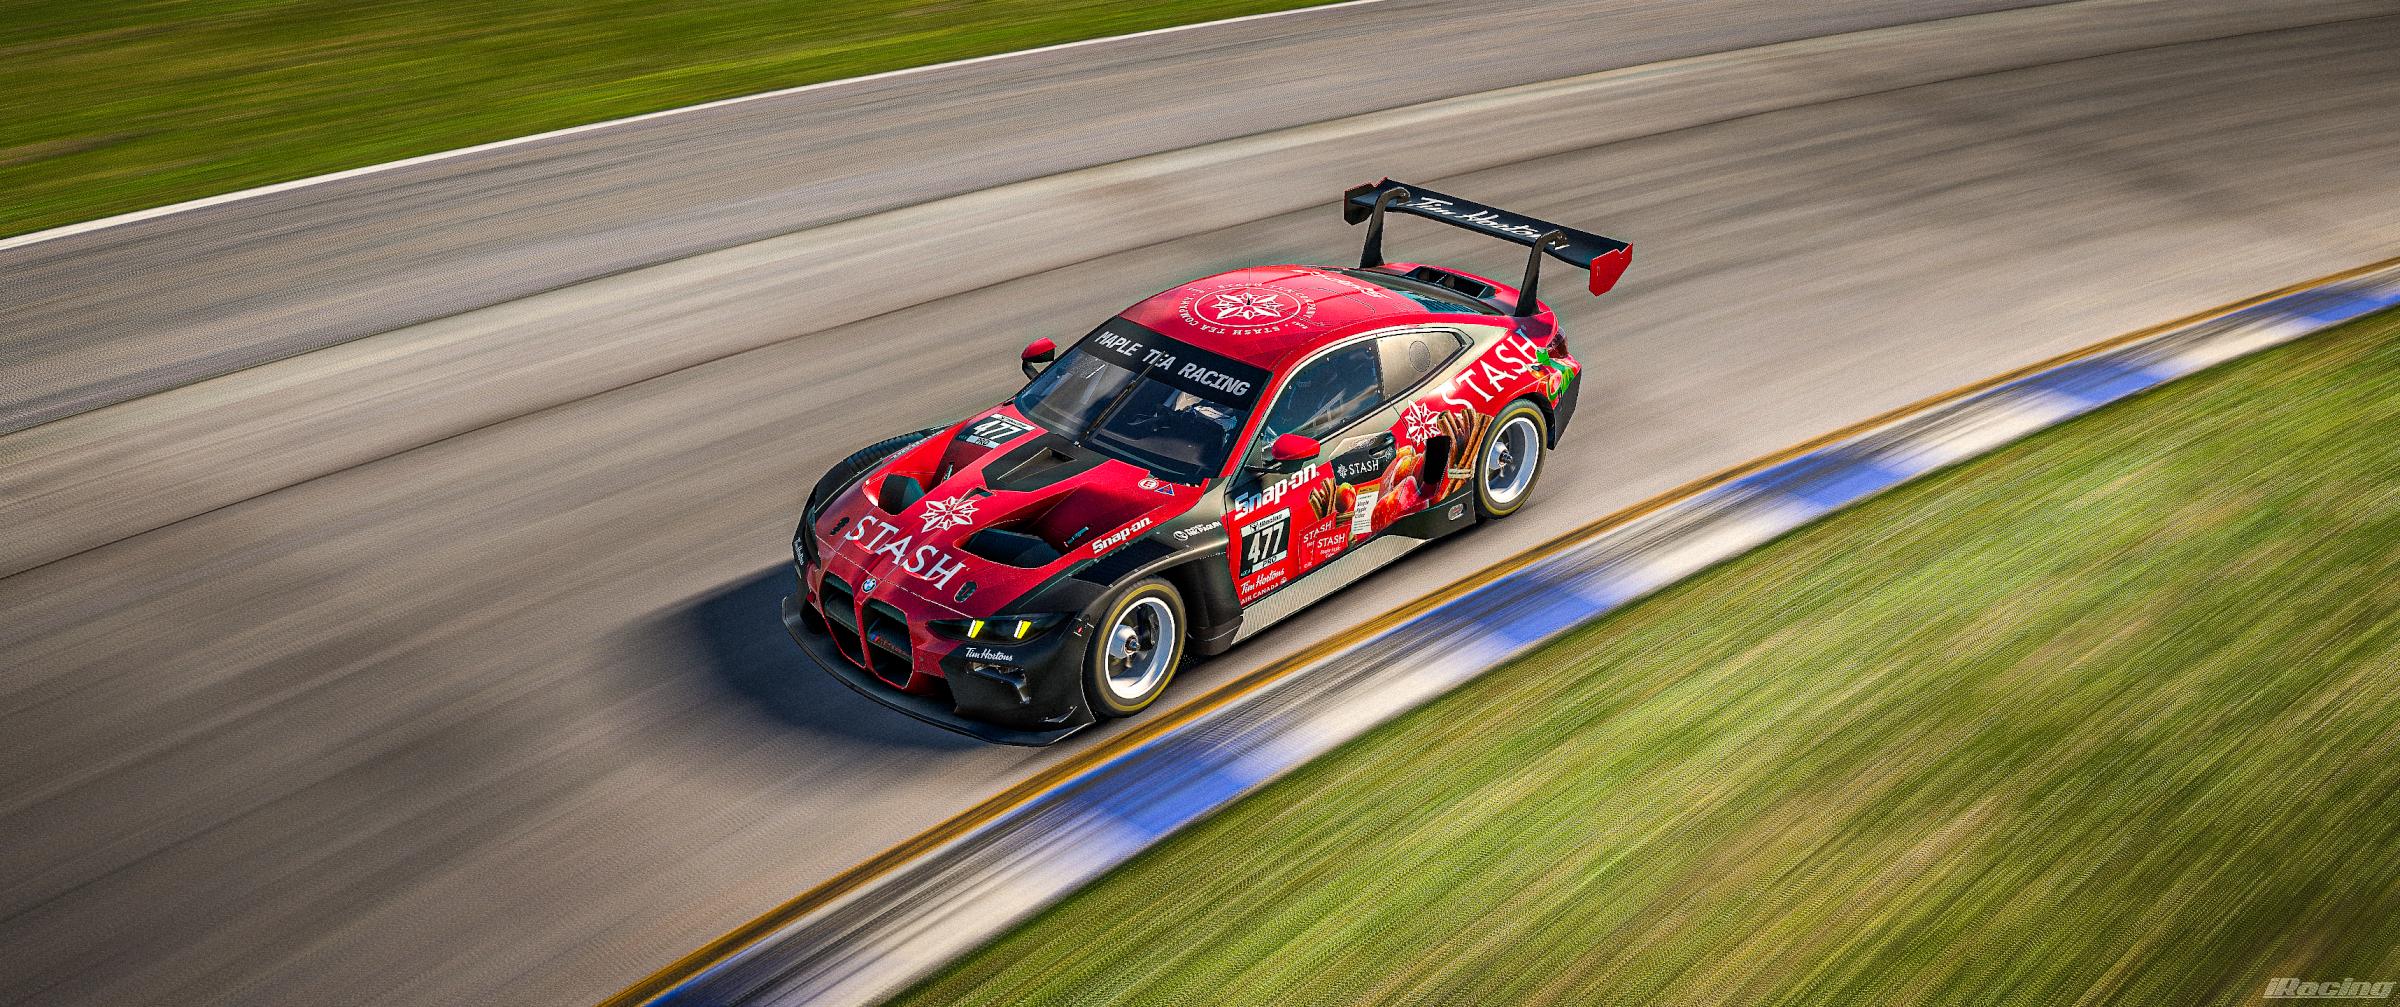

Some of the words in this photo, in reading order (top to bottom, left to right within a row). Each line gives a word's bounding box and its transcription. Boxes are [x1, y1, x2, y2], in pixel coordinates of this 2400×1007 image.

[1397, 197, 1456, 215] Tim
[1454, 210, 1570, 250] Horton
[1200, 324, 1226, 335] TEA
[1094, 331, 1144, 357] MAPLE
[1177, 362, 1251, 396] RACING
[1437, 328, 1540, 419] STASH
[973, 420, 1022, 440] 477
[1348, 459, 1379, 476] STASH
[1234, 463, 1319, 521] Snap-on
[1092, 517, 1153, 555] Snap-on
[1247, 521, 1285, 564] 477
[1303, 520, 1333, 544] STASH
[1317, 532, 1346, 549] STASH
[845, 514, 967, 591] STASH
[1262, 555, 1277, 567] PRO
[1240, 580, 1255, 596] Tim
[1255, 567, 1285, 588] Hortons
[1252, 582, 1279, 599] CANADA
[965, 647, 980, 658] Tim
[980, 648, 1013, 661] Hortons
